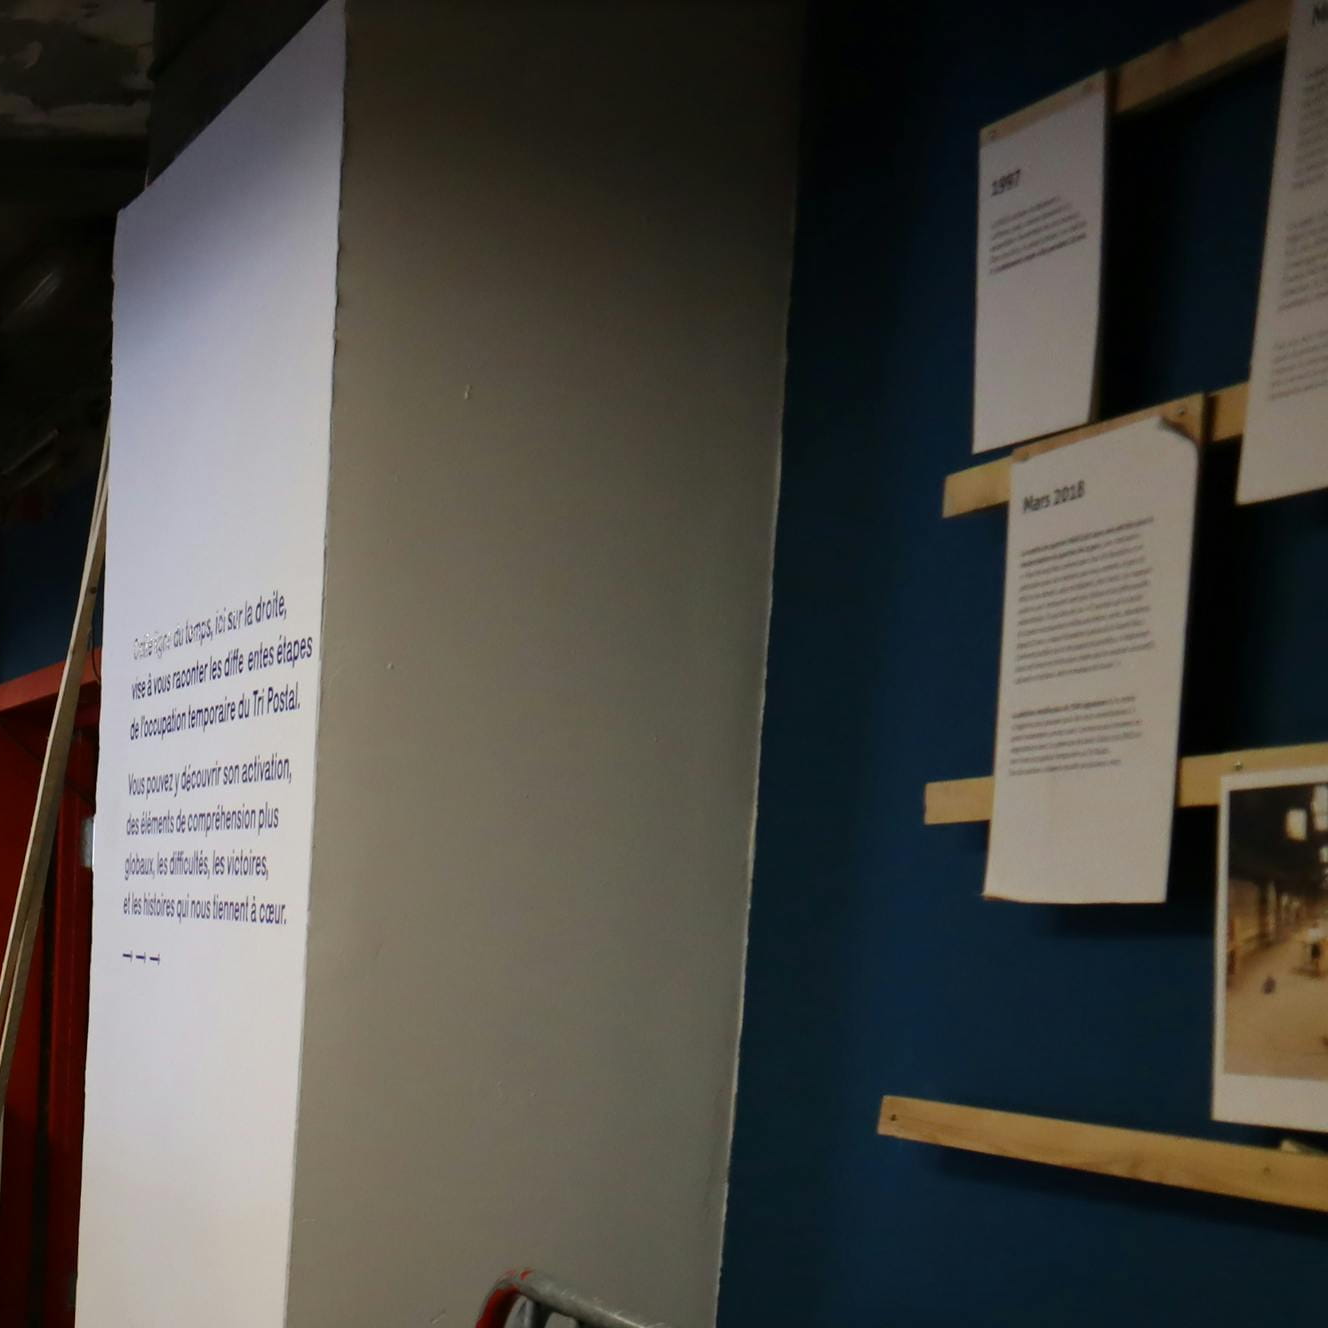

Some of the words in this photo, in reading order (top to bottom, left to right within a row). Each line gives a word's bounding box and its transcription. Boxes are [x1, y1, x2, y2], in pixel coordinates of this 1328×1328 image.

[1053, 480, 1086, 505] 2018
[216, 606, 226, 634] ici
[228, 608, 243, 632] sur
[245, 599, 253, 627] la
[256, 589, 287, 620] droite,
[132, 676, 146, 701] vise
[154, 673, 171, 696] vous
[173, 658, 209, 690] raconter
[210, 655, 222, 681] les
[276, 634, 313, 668] étapes
[130, 717, 140, 741] de
[188, 696, 236, 733] temporaire
[238, 692, 250, 720] du
[252, 688, 265, 717] Tri
[267, 681, 301, 714] Postal.
[128, 773, 145, 796] Vous
[146, 772, 173, 800] pouvez
[174, 772, 180, 798] y
[181, 760, 221, 792] découvrir
[223, 764, 240, 786] son
[241, 753, 292, 784] activation,
[126, 813, 140, 836] des
[141, 809, 175, 835] éléments
[176, 808, 186, 834] de
[188, 803, 256, 837] compréhension
[258, 801, 279, 836] plus
[124, 852, 155, 881] globaux,
[157, 851, 168, 875] les
[169, 850, 210, 880] difficultés,
[212, 849, 225, 875] les
[227, 848, 269, 880] victoires,
[123, 892, 130, 915] et
[131, 891, 142, 916] les
[143, 891, 175, 918] histoires
[176, 893, 189, 924] qui
[190, 899, 211, 920] nous
[212, 893, 249, 921] tiennent
[250, 895, 257, 922] à
